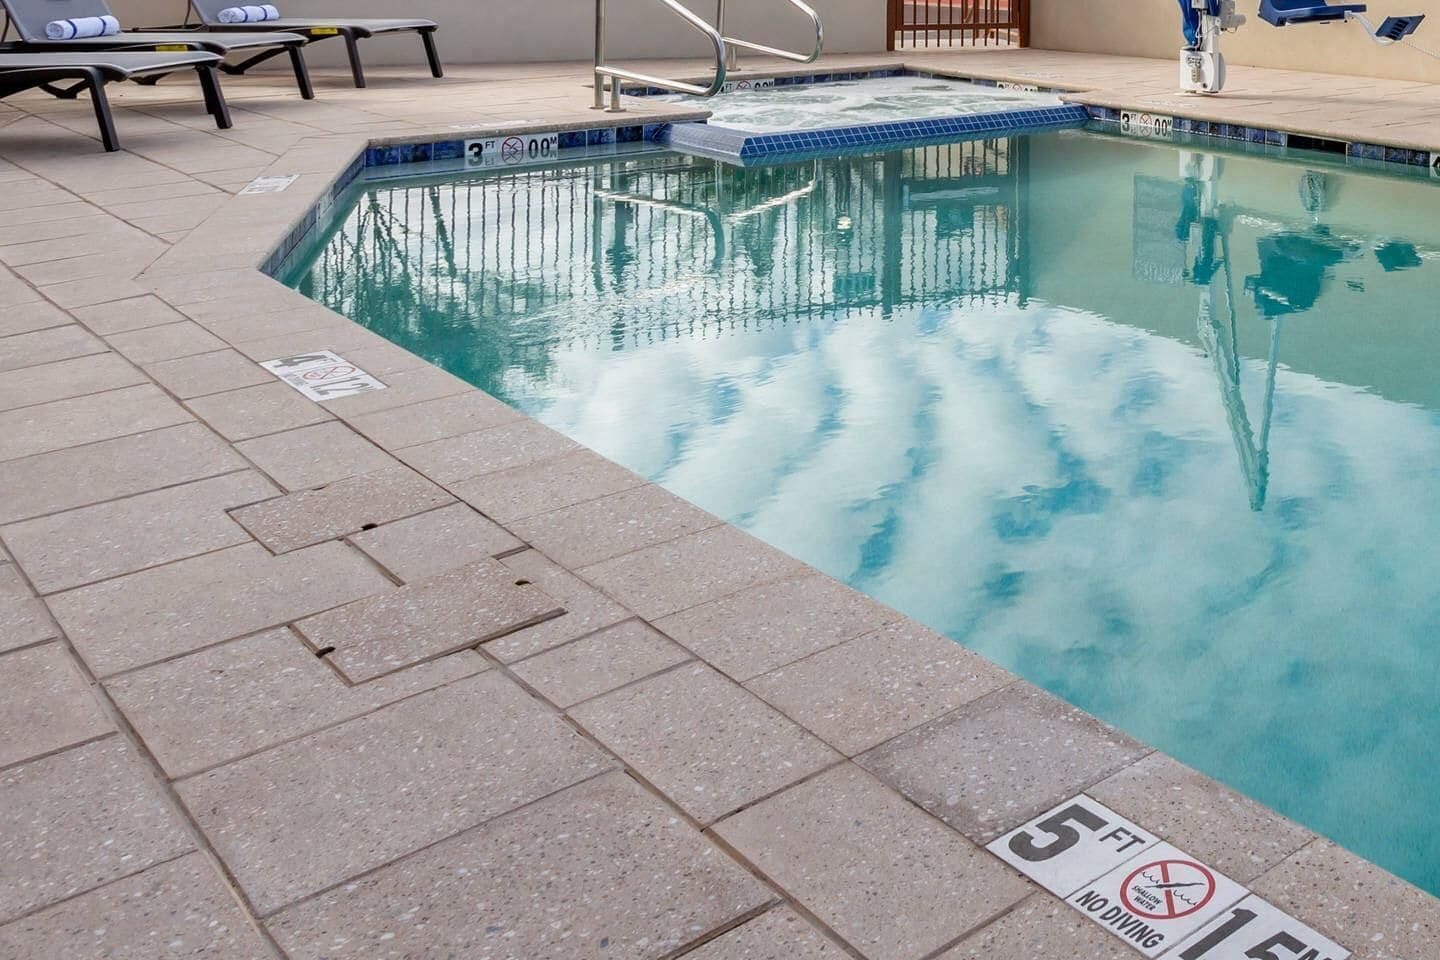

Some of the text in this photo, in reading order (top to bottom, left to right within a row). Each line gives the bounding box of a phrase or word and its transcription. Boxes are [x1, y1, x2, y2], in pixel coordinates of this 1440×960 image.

[485, 140, 496, 150] FT
[1008, 803, 1109, 863] 5
[1099, 826, 1147, 854] FT
[1074, 889, 1166, 949] NO DIVING
